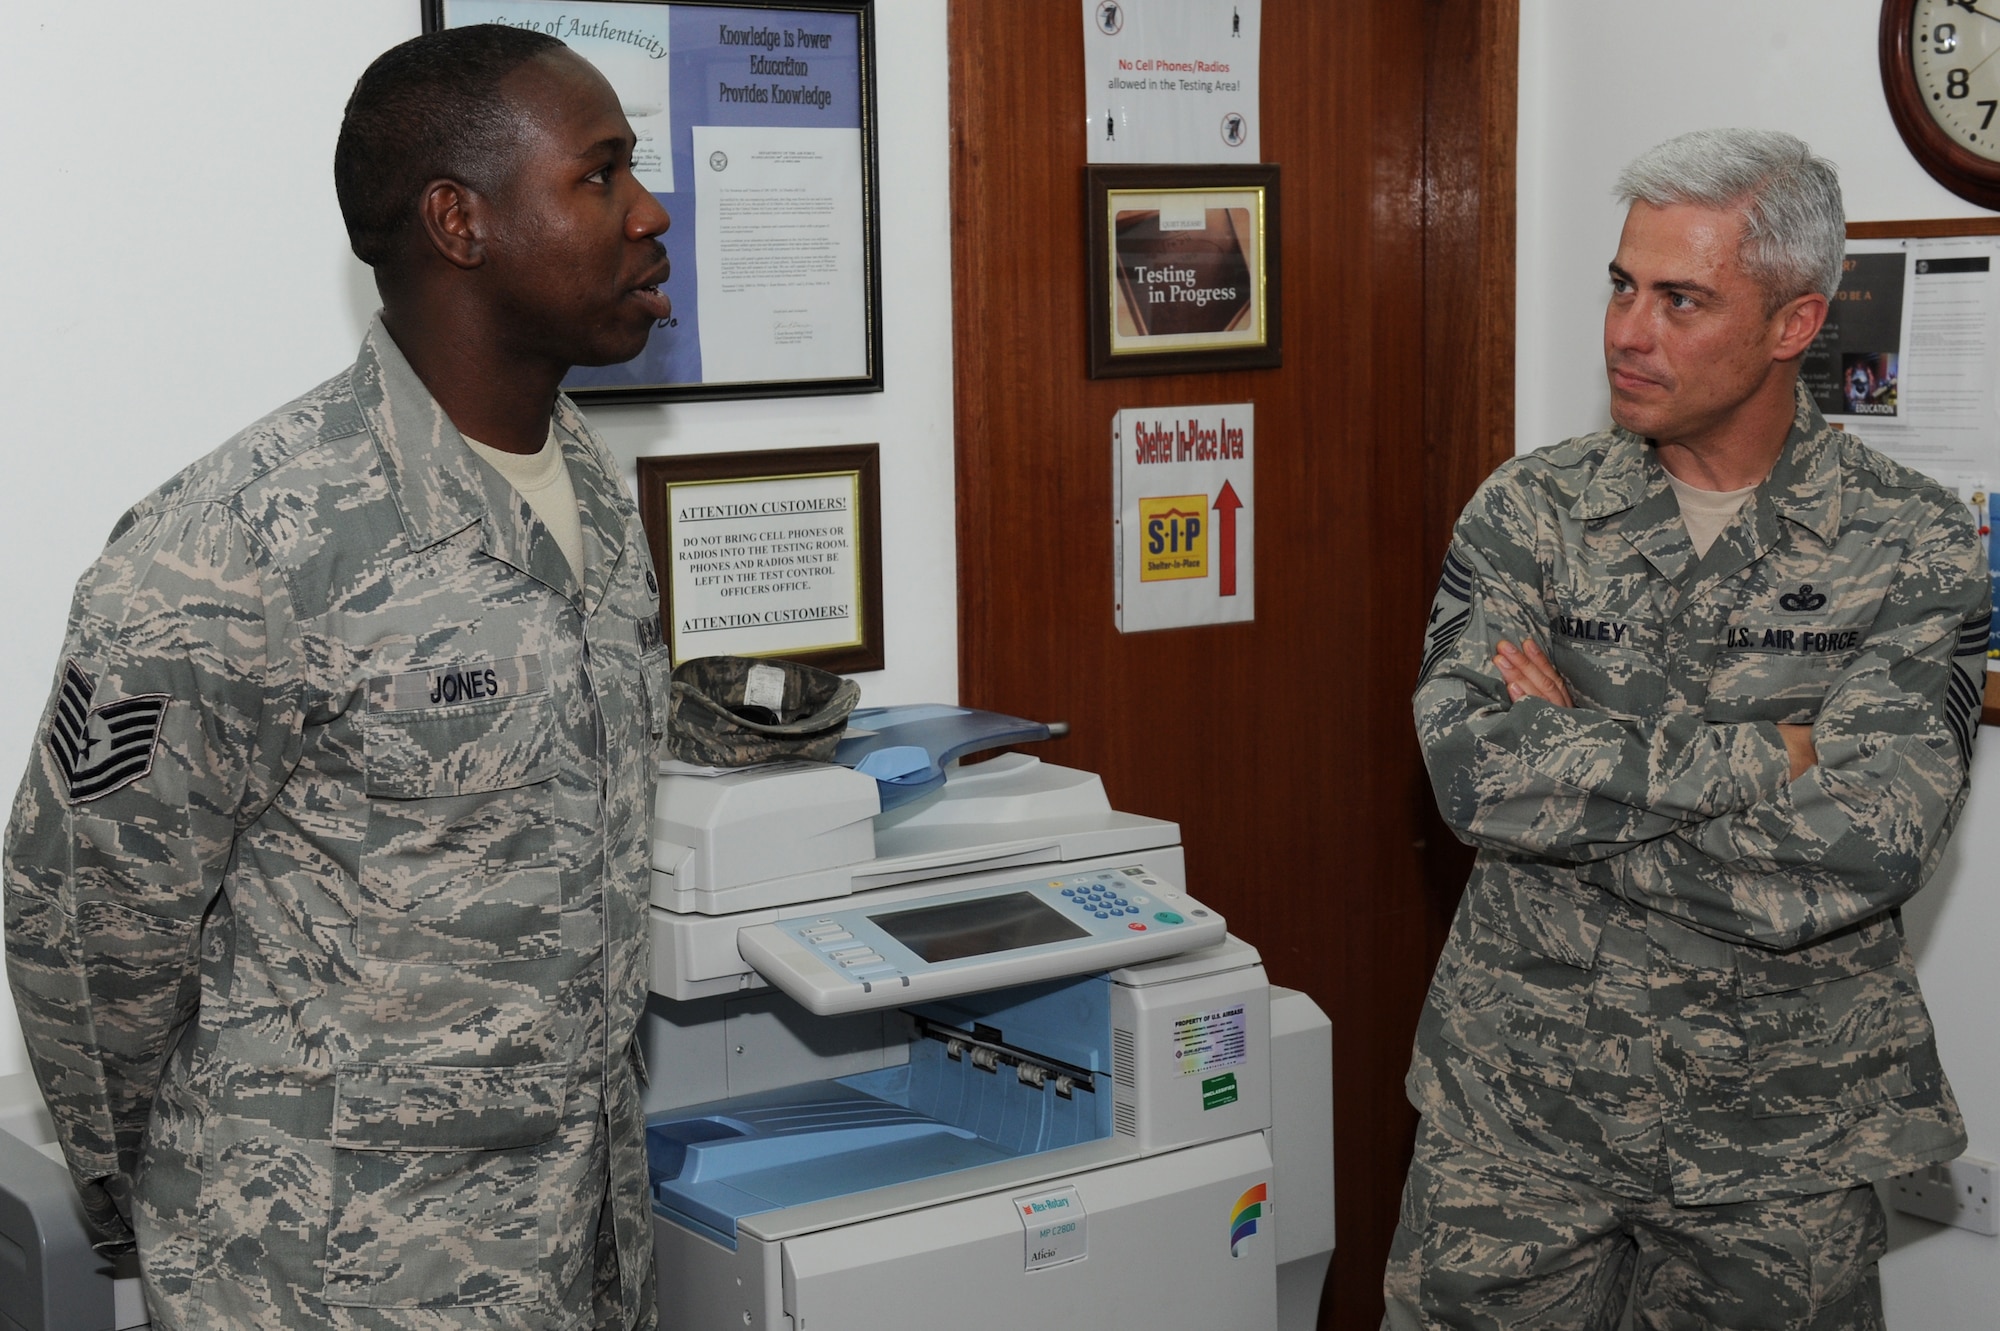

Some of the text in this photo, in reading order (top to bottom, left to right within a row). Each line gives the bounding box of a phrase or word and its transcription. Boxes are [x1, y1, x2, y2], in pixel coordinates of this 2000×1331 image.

[545, 15, 566, 38] of
[563, 18, 668, 60] Authenticity
[719, 24, 832, 51] Knowledge is Power
[1933, 23, 1956, 55] 9
[750, 54, 808, 76] Education
[1118, 59, 1230, 74] No Cell Phones/Radios
[1108, 78, 1240, 94] allowed in the Testing Area!
[1946, 68, 1969, 100] 8
[719, 82, 831, 110] Provides Knowledge
[1976, 100, 1998, 130] 7
[1134, 265, 1196, 287] Testing
[1149, 285, 1237, 307] in Progress
[1850, 291, 1861, 301] BE
[1864, 290, 1872, 301] A
[1855, 403, 1894, 414] EDUCATION
[1136, 418, 1244, 465] Shelter In-Place Area
[679, 497, 847, 520] ATTENTION CUSTOMERS!
[683, 526, 844, 548] DO NOT BRING CELL PHONES OR
[679, 539, 848, 561] RADIOS INTO THE TESTING ROOM.
[690, 552, 839, 574] PHONES AND RADIOS MUST BE
[695, 566, 835, 587] LEFT IN THE TEST CONTROL
[720, 581, 811, 597] OFFICERS OFFICE.
[682, 604, 848, 631] ATTENTION CUSTOMERS!
[1560, 615, 1627, 643] SEALEY
[1727, 627, 1859, 652] U.S. AIR FORCE
[430, 669, 498, 704] JONES
[1175, 1017, 1202, 1027] PROPERTY
[1040, 1222, 1076, 1238] MP C2800
